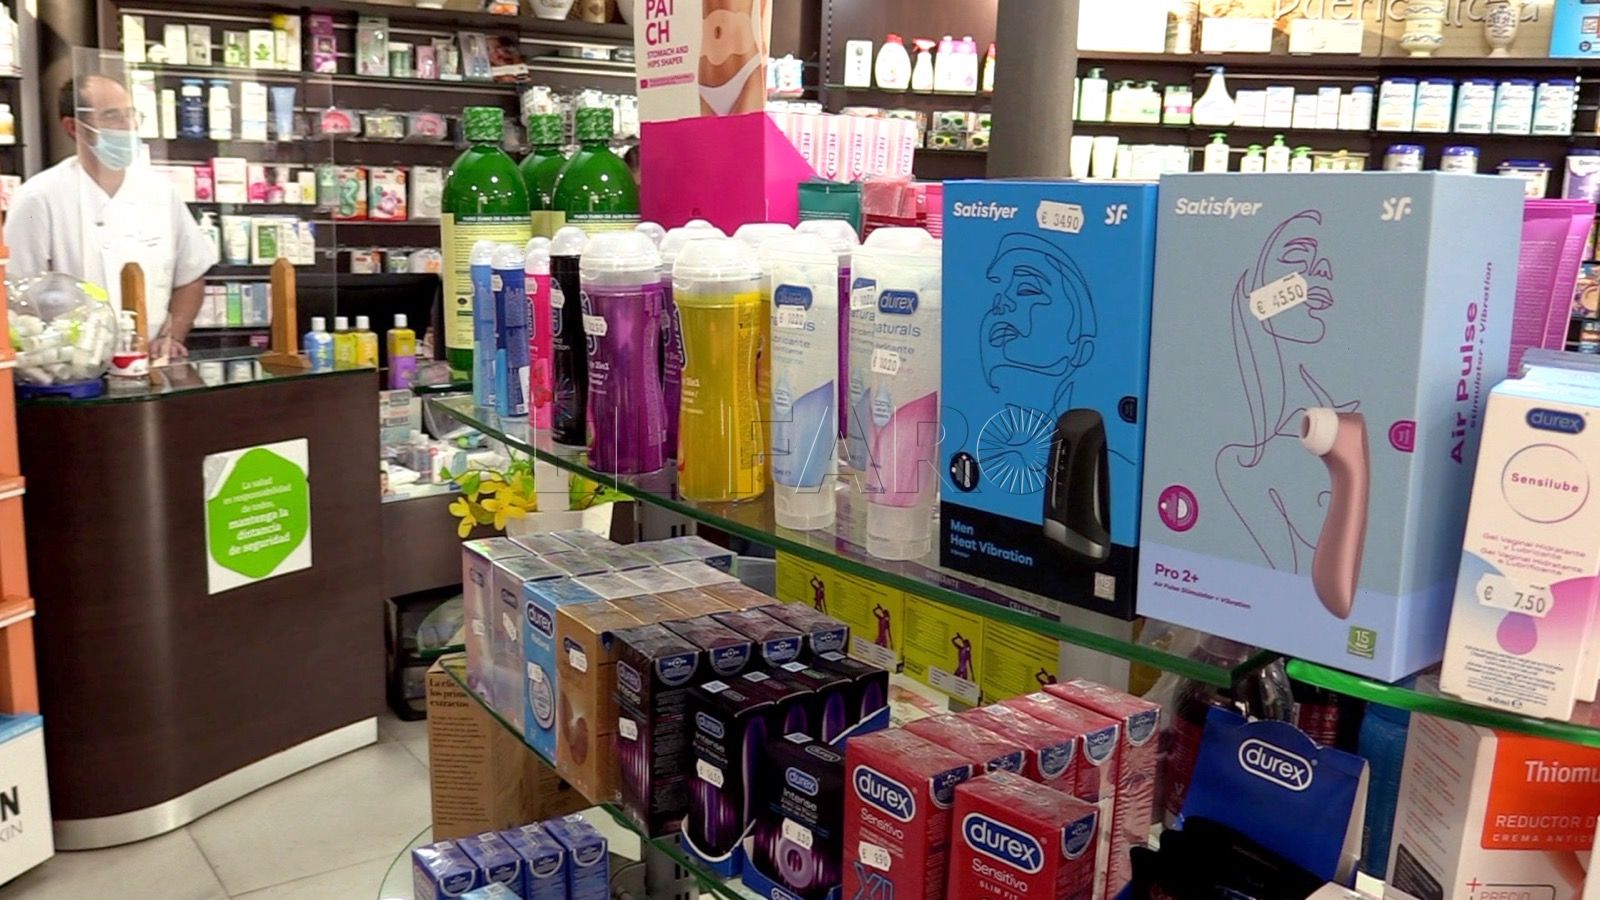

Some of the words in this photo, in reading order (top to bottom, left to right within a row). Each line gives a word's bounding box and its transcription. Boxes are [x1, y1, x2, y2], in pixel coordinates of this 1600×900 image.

[646, 21, 670, 46] CH
[952, 201, 1018, 222] Satisfyer
[1175, 196, 1263, 219] Satisfyer
[879, 292, 916, 313] durex
[1257, 301, 1266, 315] €
[1479, 261, 1493, 333] Vibration
[875, 323, 921, 337] aturals
[1456, 302, 1479, 402] Pulse
[1530, 410, 1581, 433] durex
[1450, 411, 1468, 465] Air
[1511, 472, 1580, 493] Sensilube
[950, 519, 974, 536] Men
[1482, 532, 1498, 541] Gel
[950, 534, 977, 552] Heat
[979, 542, 1034, 567] Vibration
[1480, 547, 1496, 556] Gel
[1155, 562, 1180, 580] Pro
[1181, 568, 1200, 583] 2+
[1484, 585, 1494, 601] €
[1513, 591, 1547, 614] 7.50
[1355, 630, 1371, 644] 15
[1245, 747, 1306, 788] durex
[782, 787, 818, 812] Intense
[858, 773, 910, 819] durex
[860, 807, 904, 840] Sensitivo
[1495, 815, 1582, 829] REDUCTOR
[1585, 815, 1596, 829] D
[970, 821, 1037, 870] durex
[1492, 834, 1540, 843] CREMA
[1546, 834, 1593, 843] ANTIC
[971, 857, 1029, 893] Sensitivo
[979, 880, 1001, 895] SLIM
[1003, 890, 1018, 900] FIT
